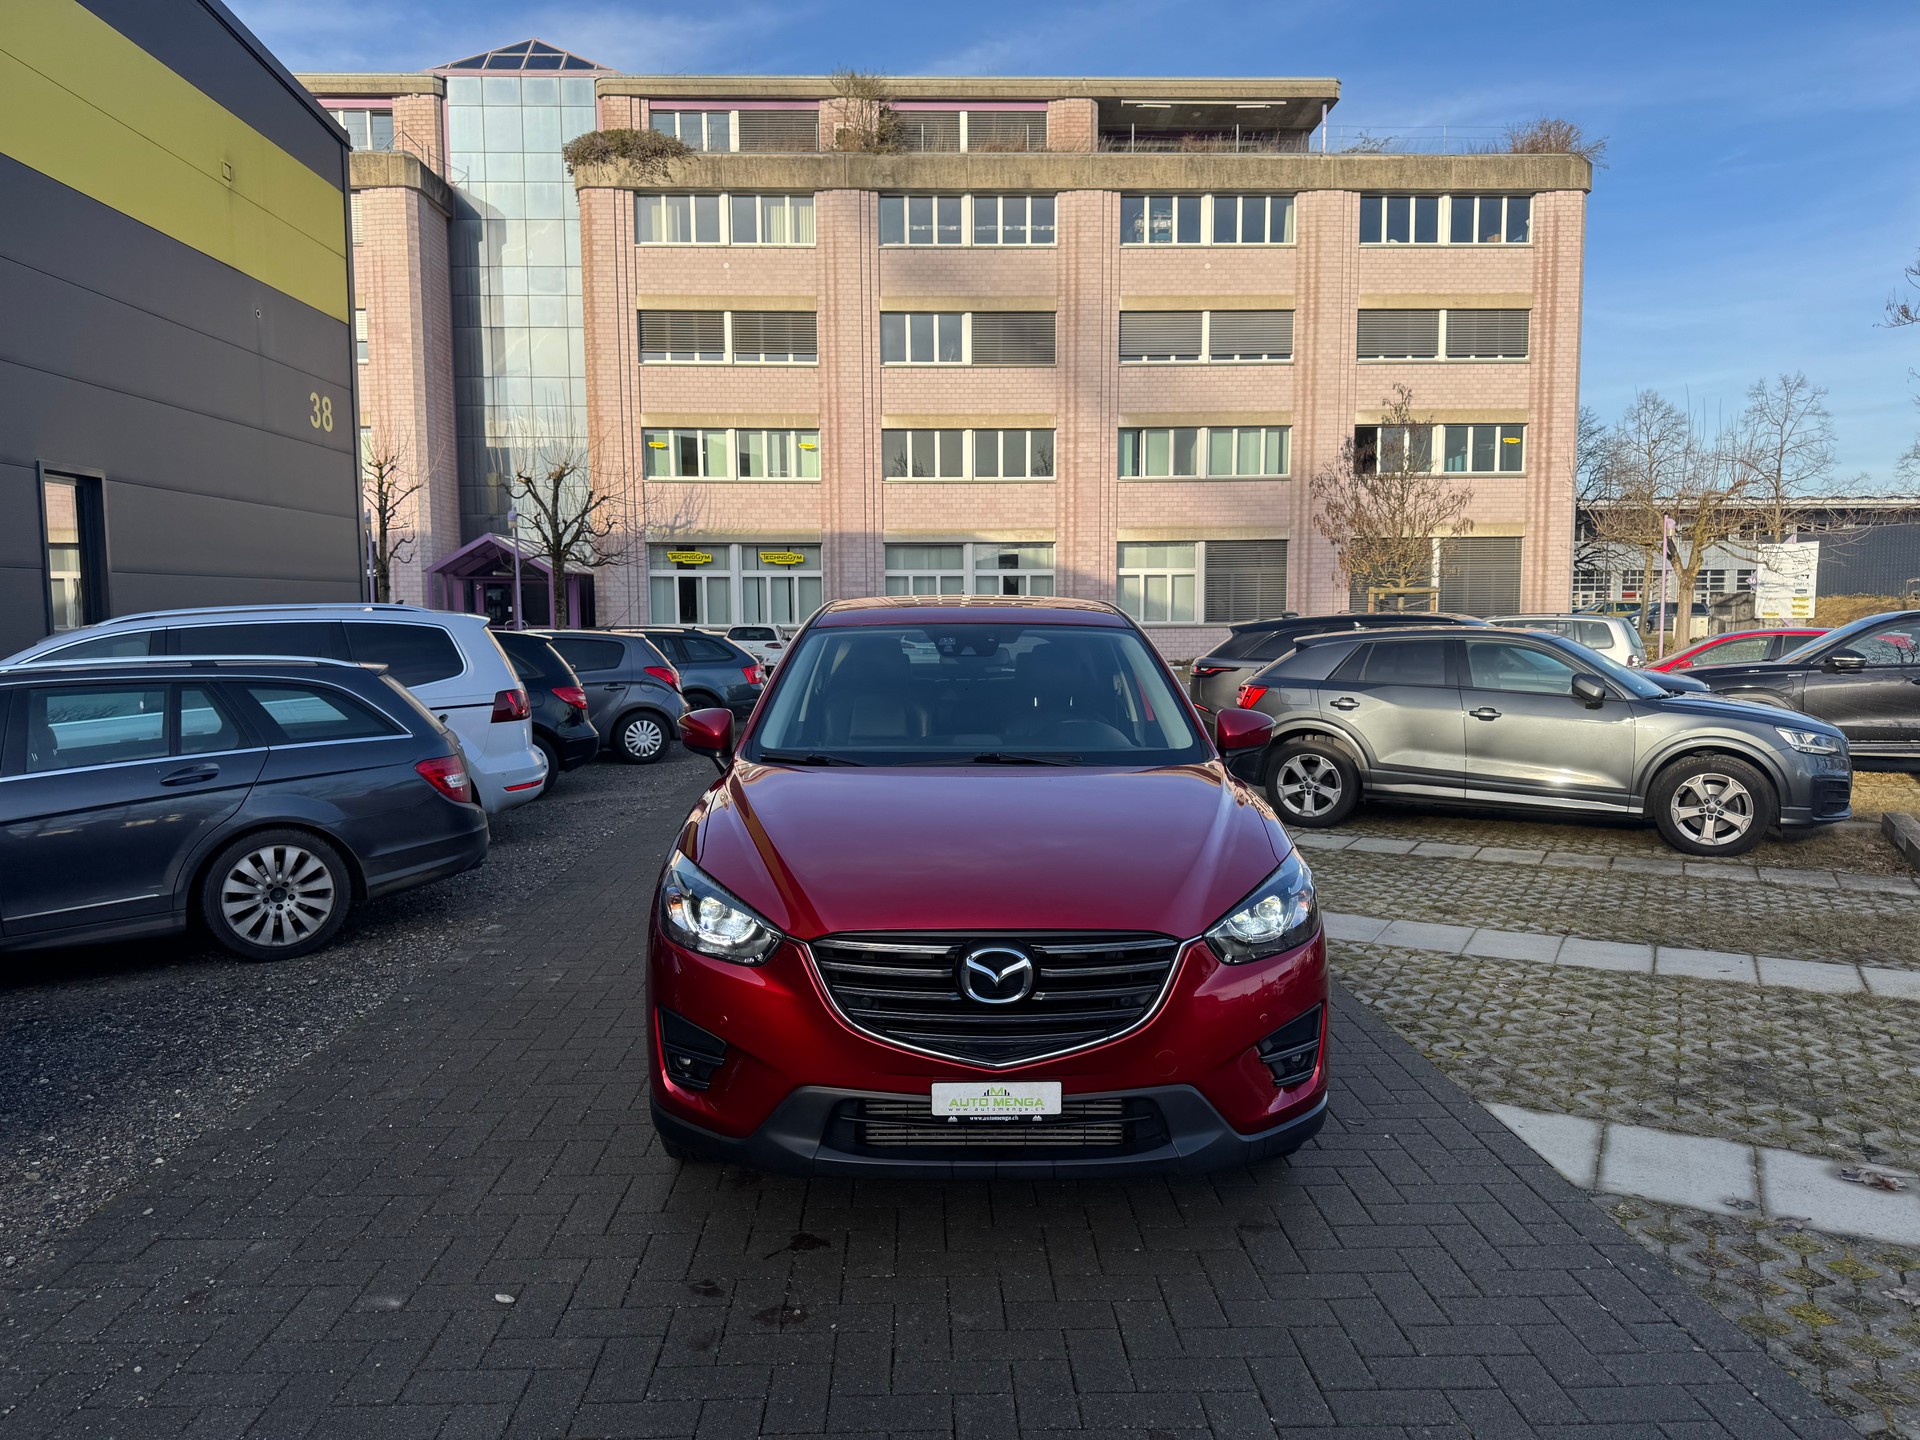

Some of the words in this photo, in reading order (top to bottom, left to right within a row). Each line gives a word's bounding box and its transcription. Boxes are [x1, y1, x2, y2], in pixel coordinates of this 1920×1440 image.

[310, 391, 334, 432] 38
[949, 1098, 989, 1107] AUTO
[993, 1098, 1045, 1107] MENGA
